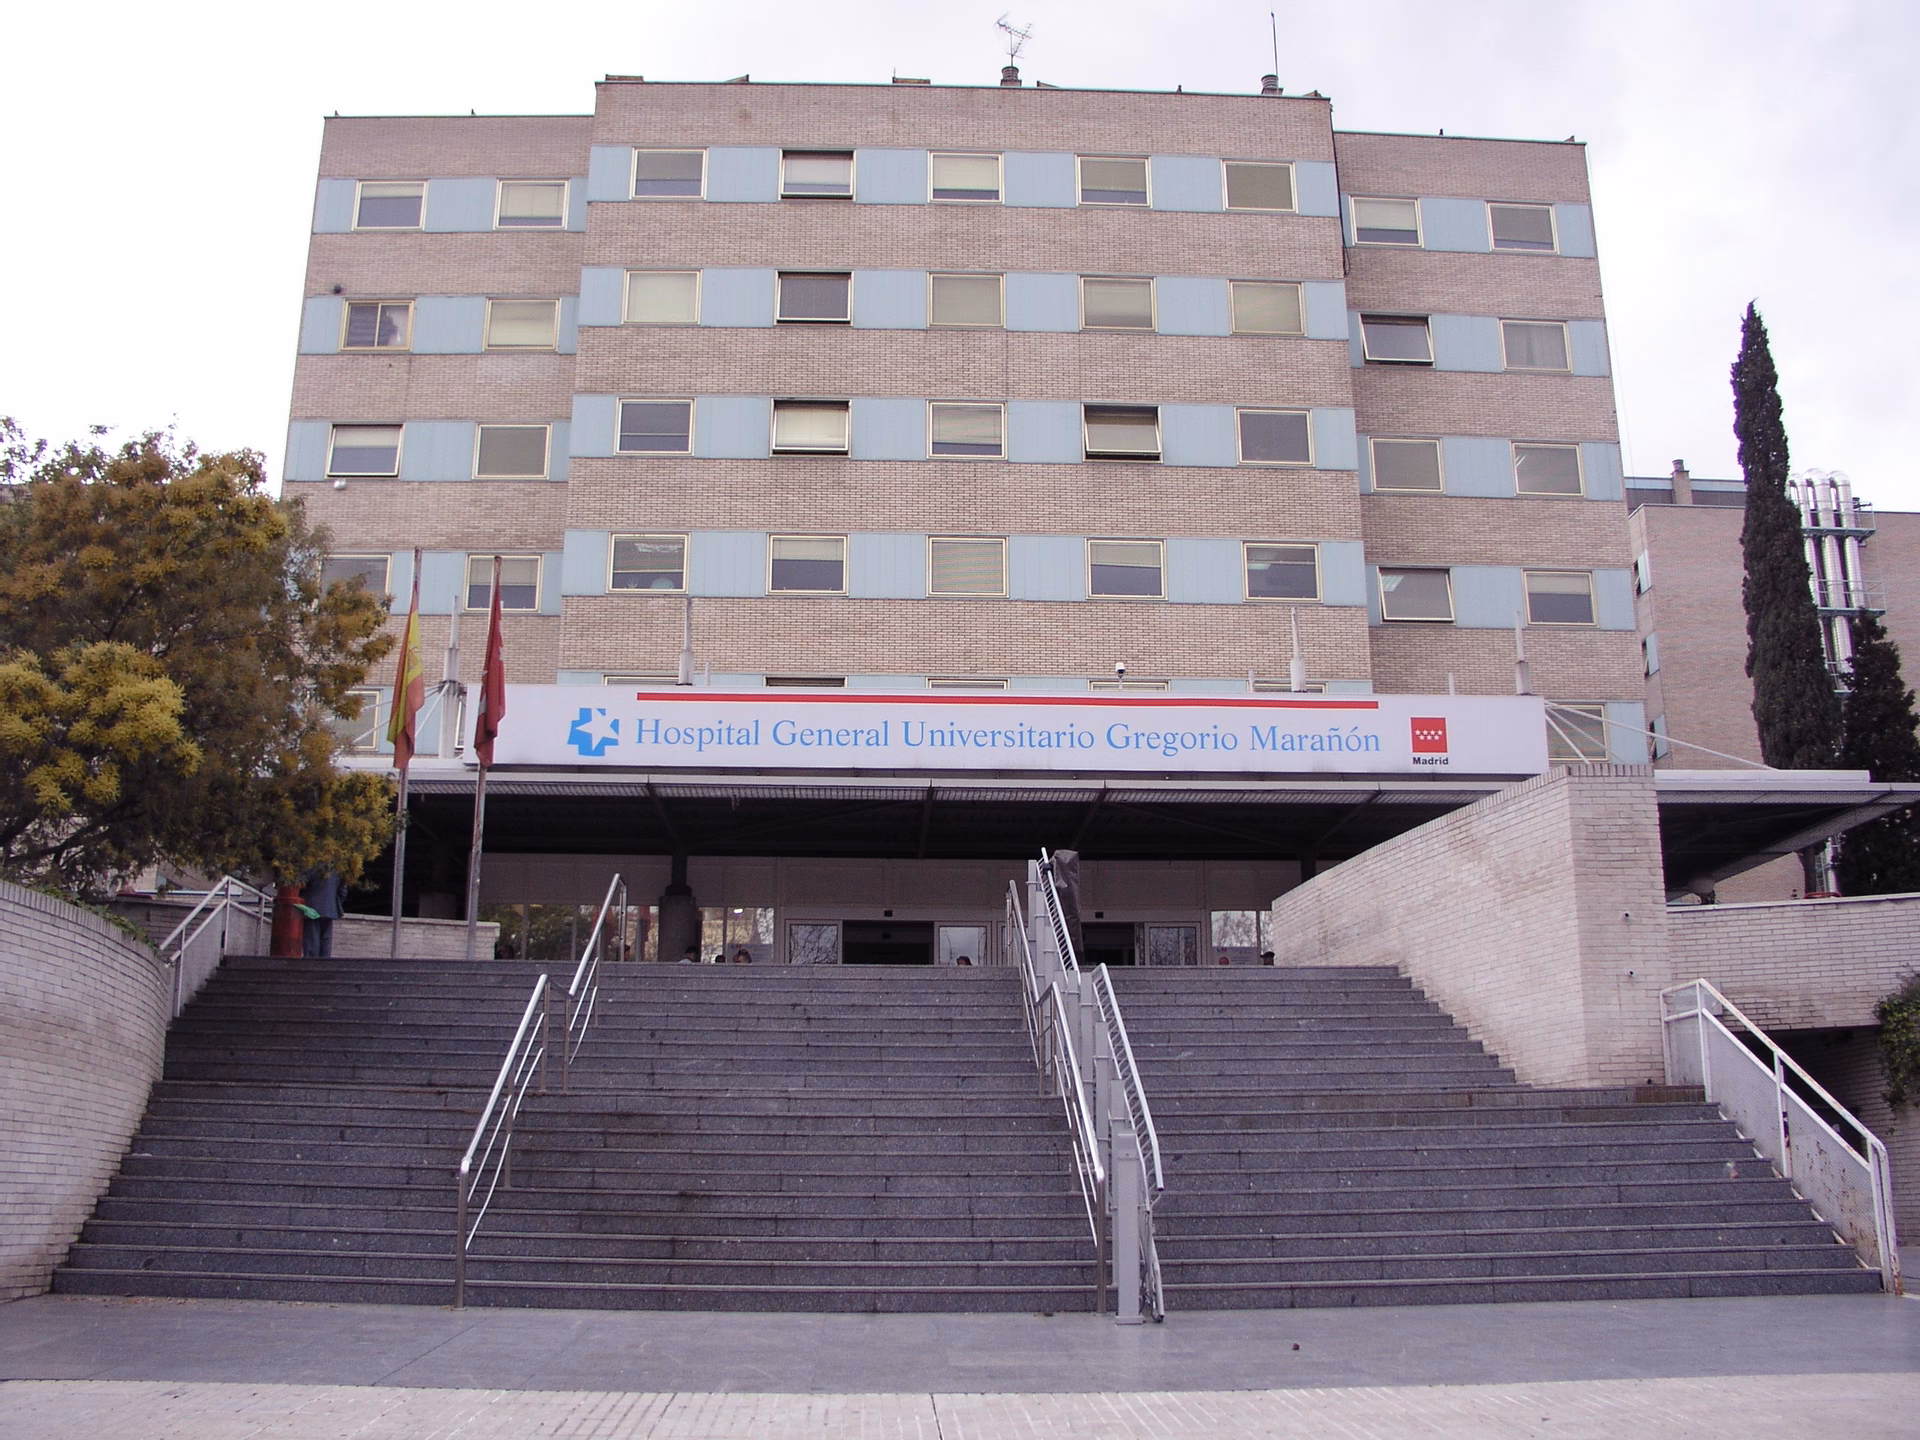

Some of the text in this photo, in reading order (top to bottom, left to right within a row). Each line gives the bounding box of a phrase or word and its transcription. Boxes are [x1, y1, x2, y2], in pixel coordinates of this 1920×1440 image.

[636, 718, 1381, 757] Hospital General Universitario Gregorio Marañón
[1412, 756, 1449, 765] Madrid
